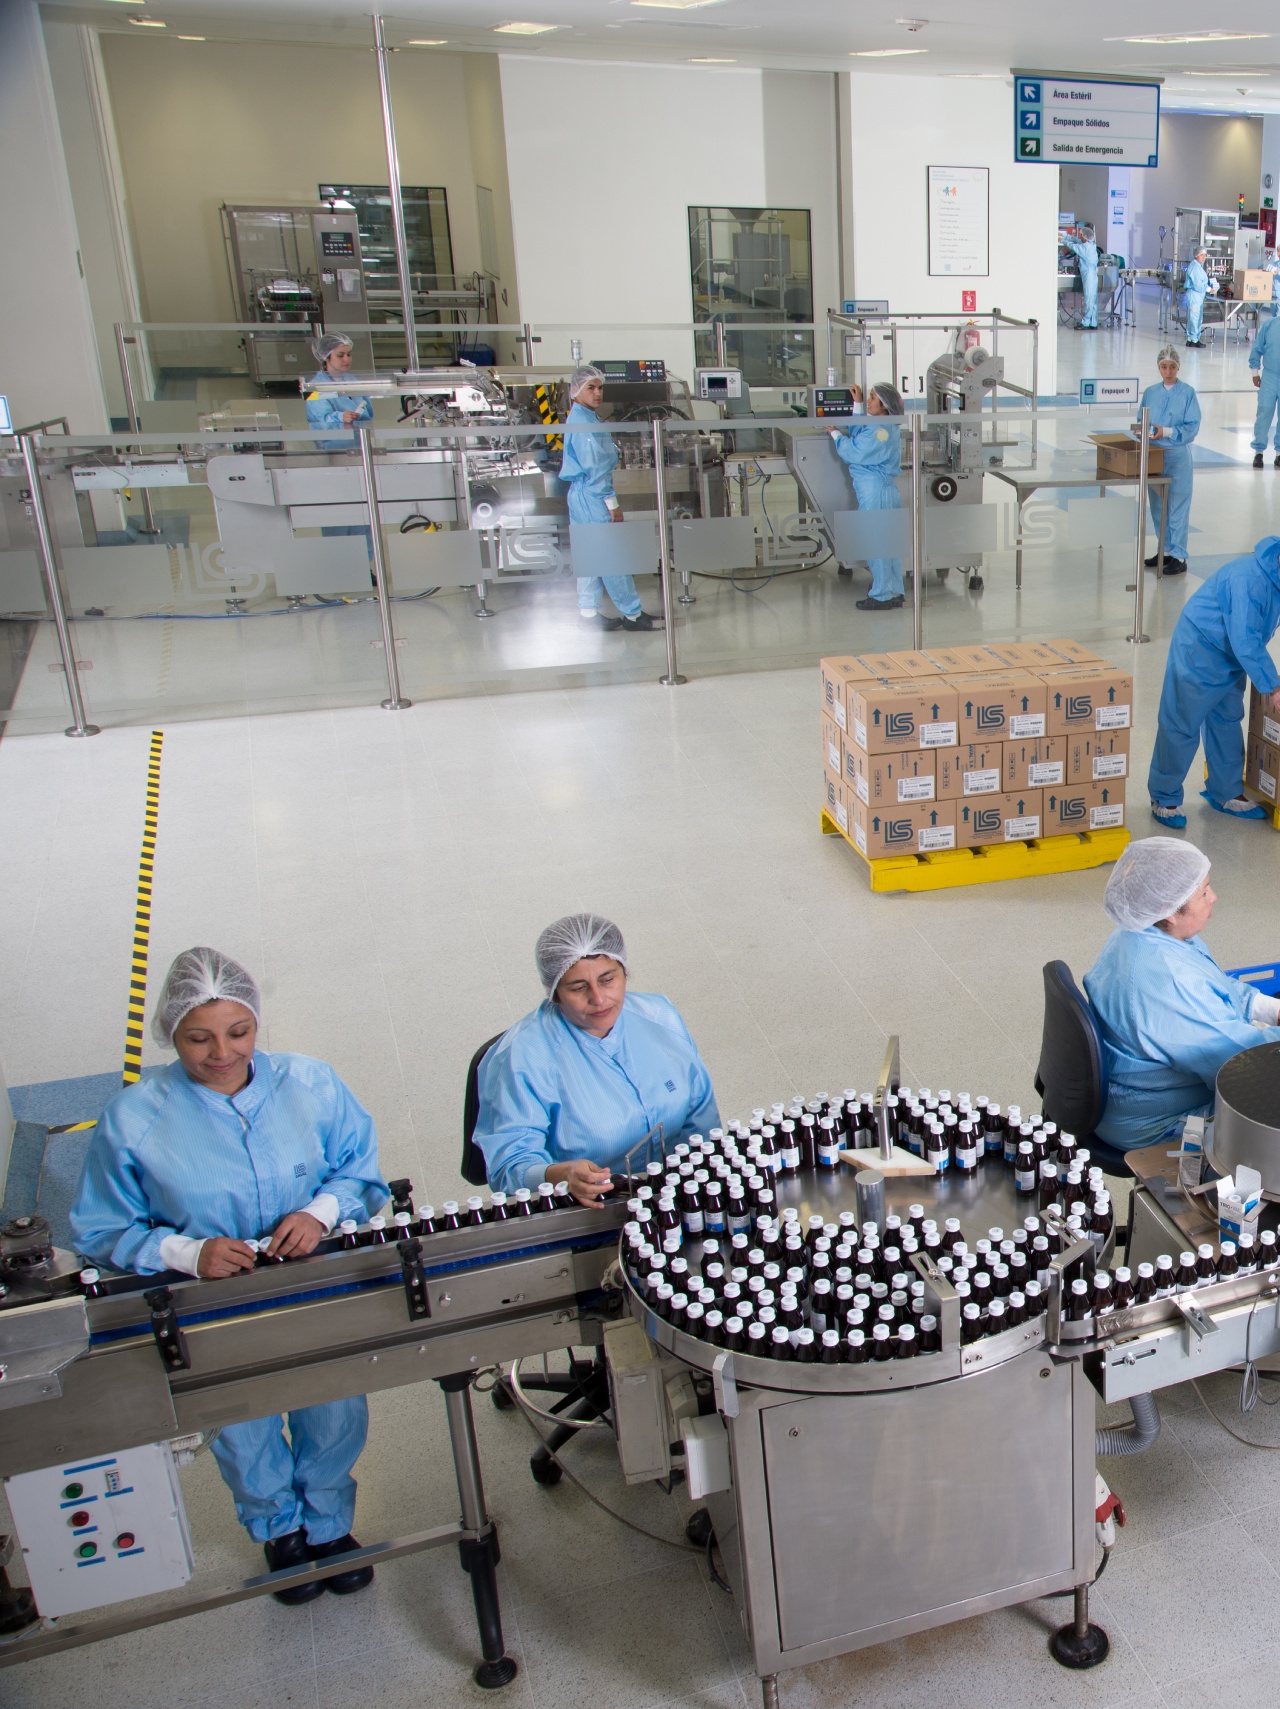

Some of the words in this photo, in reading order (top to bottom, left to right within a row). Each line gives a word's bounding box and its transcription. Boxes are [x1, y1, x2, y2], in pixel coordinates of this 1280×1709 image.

[1053, 89, 1069, 99] Área
[1070, 91, 1092, 100] Estéril
[1053, 117, 1084, 127] Empaque
[1085, 118, 1110, 128] Sólidos
[1052, 144, 1074, 153] Salida
[1075, 145, 1084, 153] de
[1085, 145, 1124, 155] Emergencia
[977, 704, 1006, 729] LS
[1065, 695, 1093, 720] LS
[885, 712, 915, 737] LS
[974, 808, 1002, 833] LS
[1060, 797, 1087, 822] LS
[884, 819, 914, 844] LS
